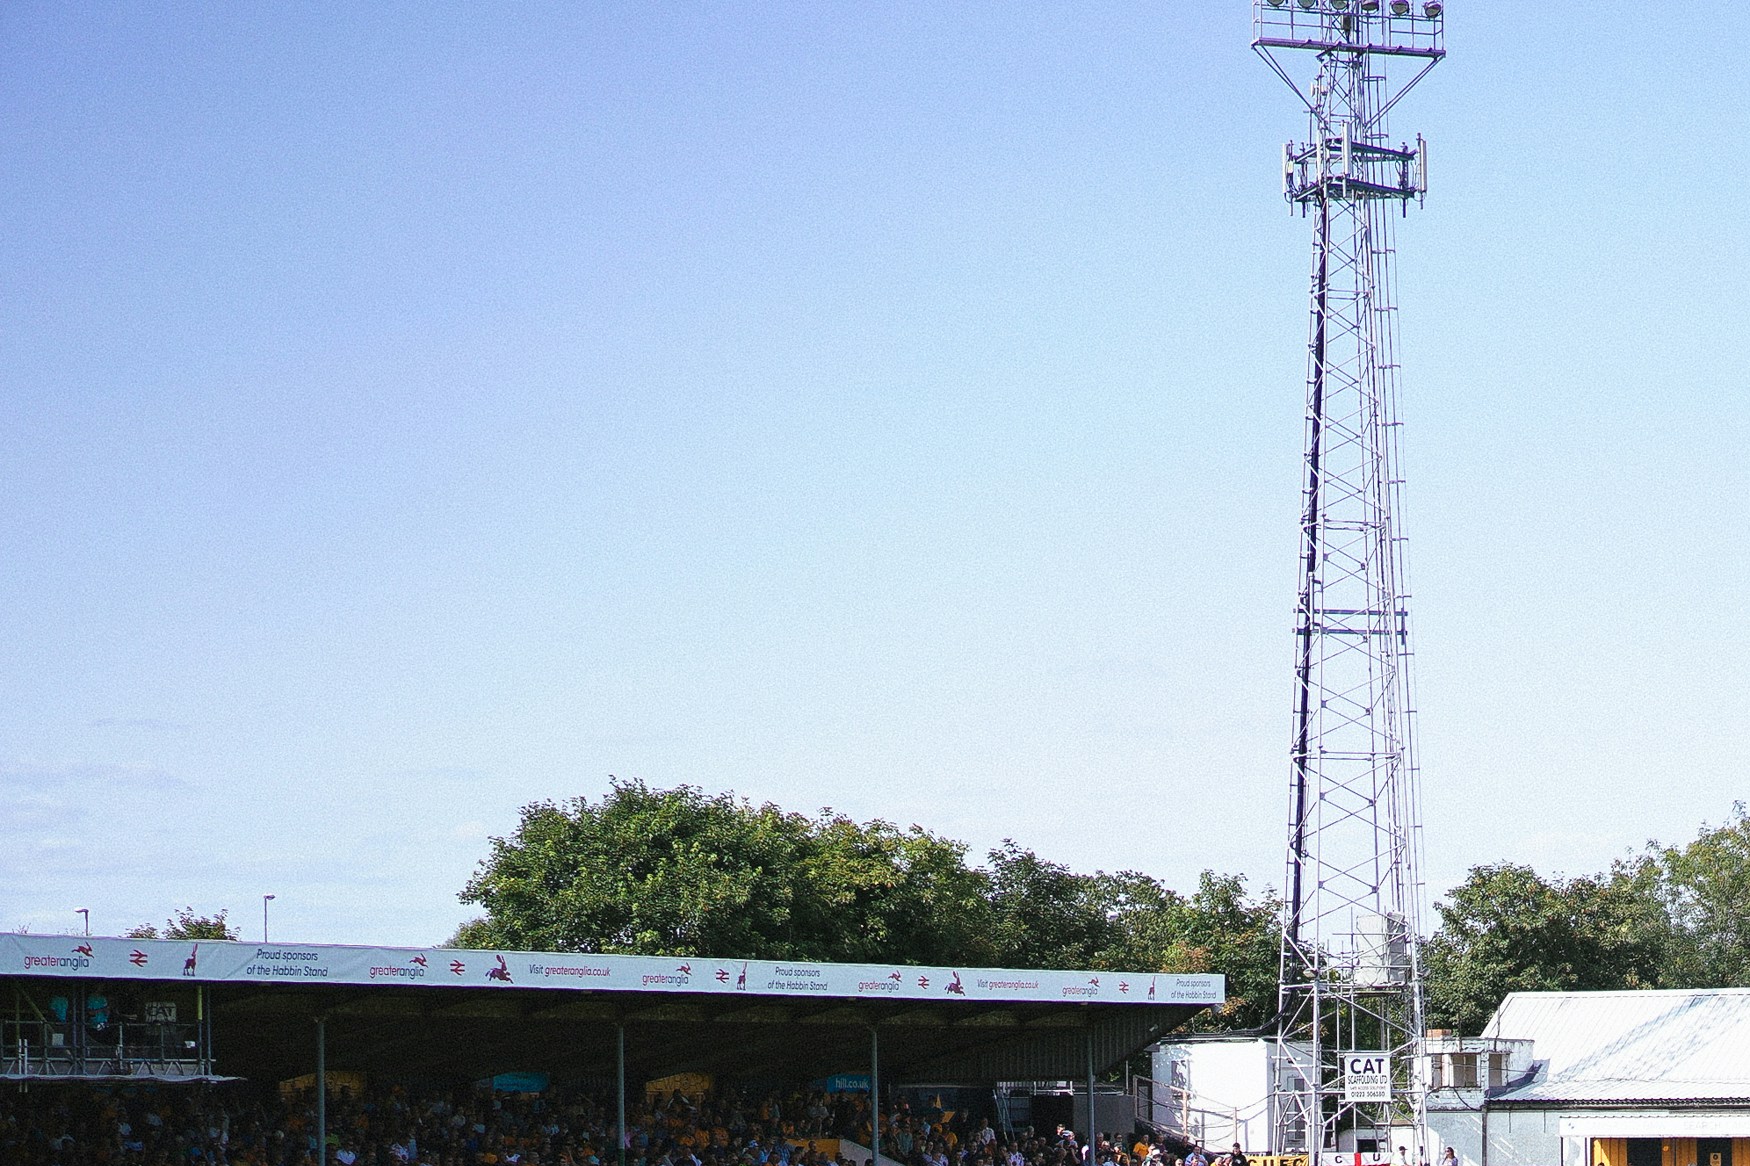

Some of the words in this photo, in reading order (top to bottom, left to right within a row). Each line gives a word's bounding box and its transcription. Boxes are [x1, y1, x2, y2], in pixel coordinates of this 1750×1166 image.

[24, 954, 89, 971] greateranglia
[257, 948, 280, 962] Proud
[282, 951, 318, 964] sponsors
[247, 964, 256, 975] of
[257, 964, 270, 976] the
[272, 965, 300, 977] Habbin
[302, 966, 328, 977] Stand
[369, 965, 425, 980] greateranglia
[529, 964, 543, 975] Visit
[545, 965, 611, 978] greateranglia.co.uk
[775, 966, 793, 977] Proud
[794, 968, 820, 980] sponsors
[642, 972, 689, 987] greateranglia
[768, 979, 776, 990] of
[777, 980, 787, 990] the
[810, 981, 828, 992] Stand
[858, 980, 900, 993] greateranglia
[977, 979, 988, 989] Visit
[1350, 1058, 1385, 1075] CAT
[1347, 1075, 1378, 1084] SCAFFOLDING
[1335, 1155, 1343, 1164] C
[1373, 1153, 1380, 1162] U
